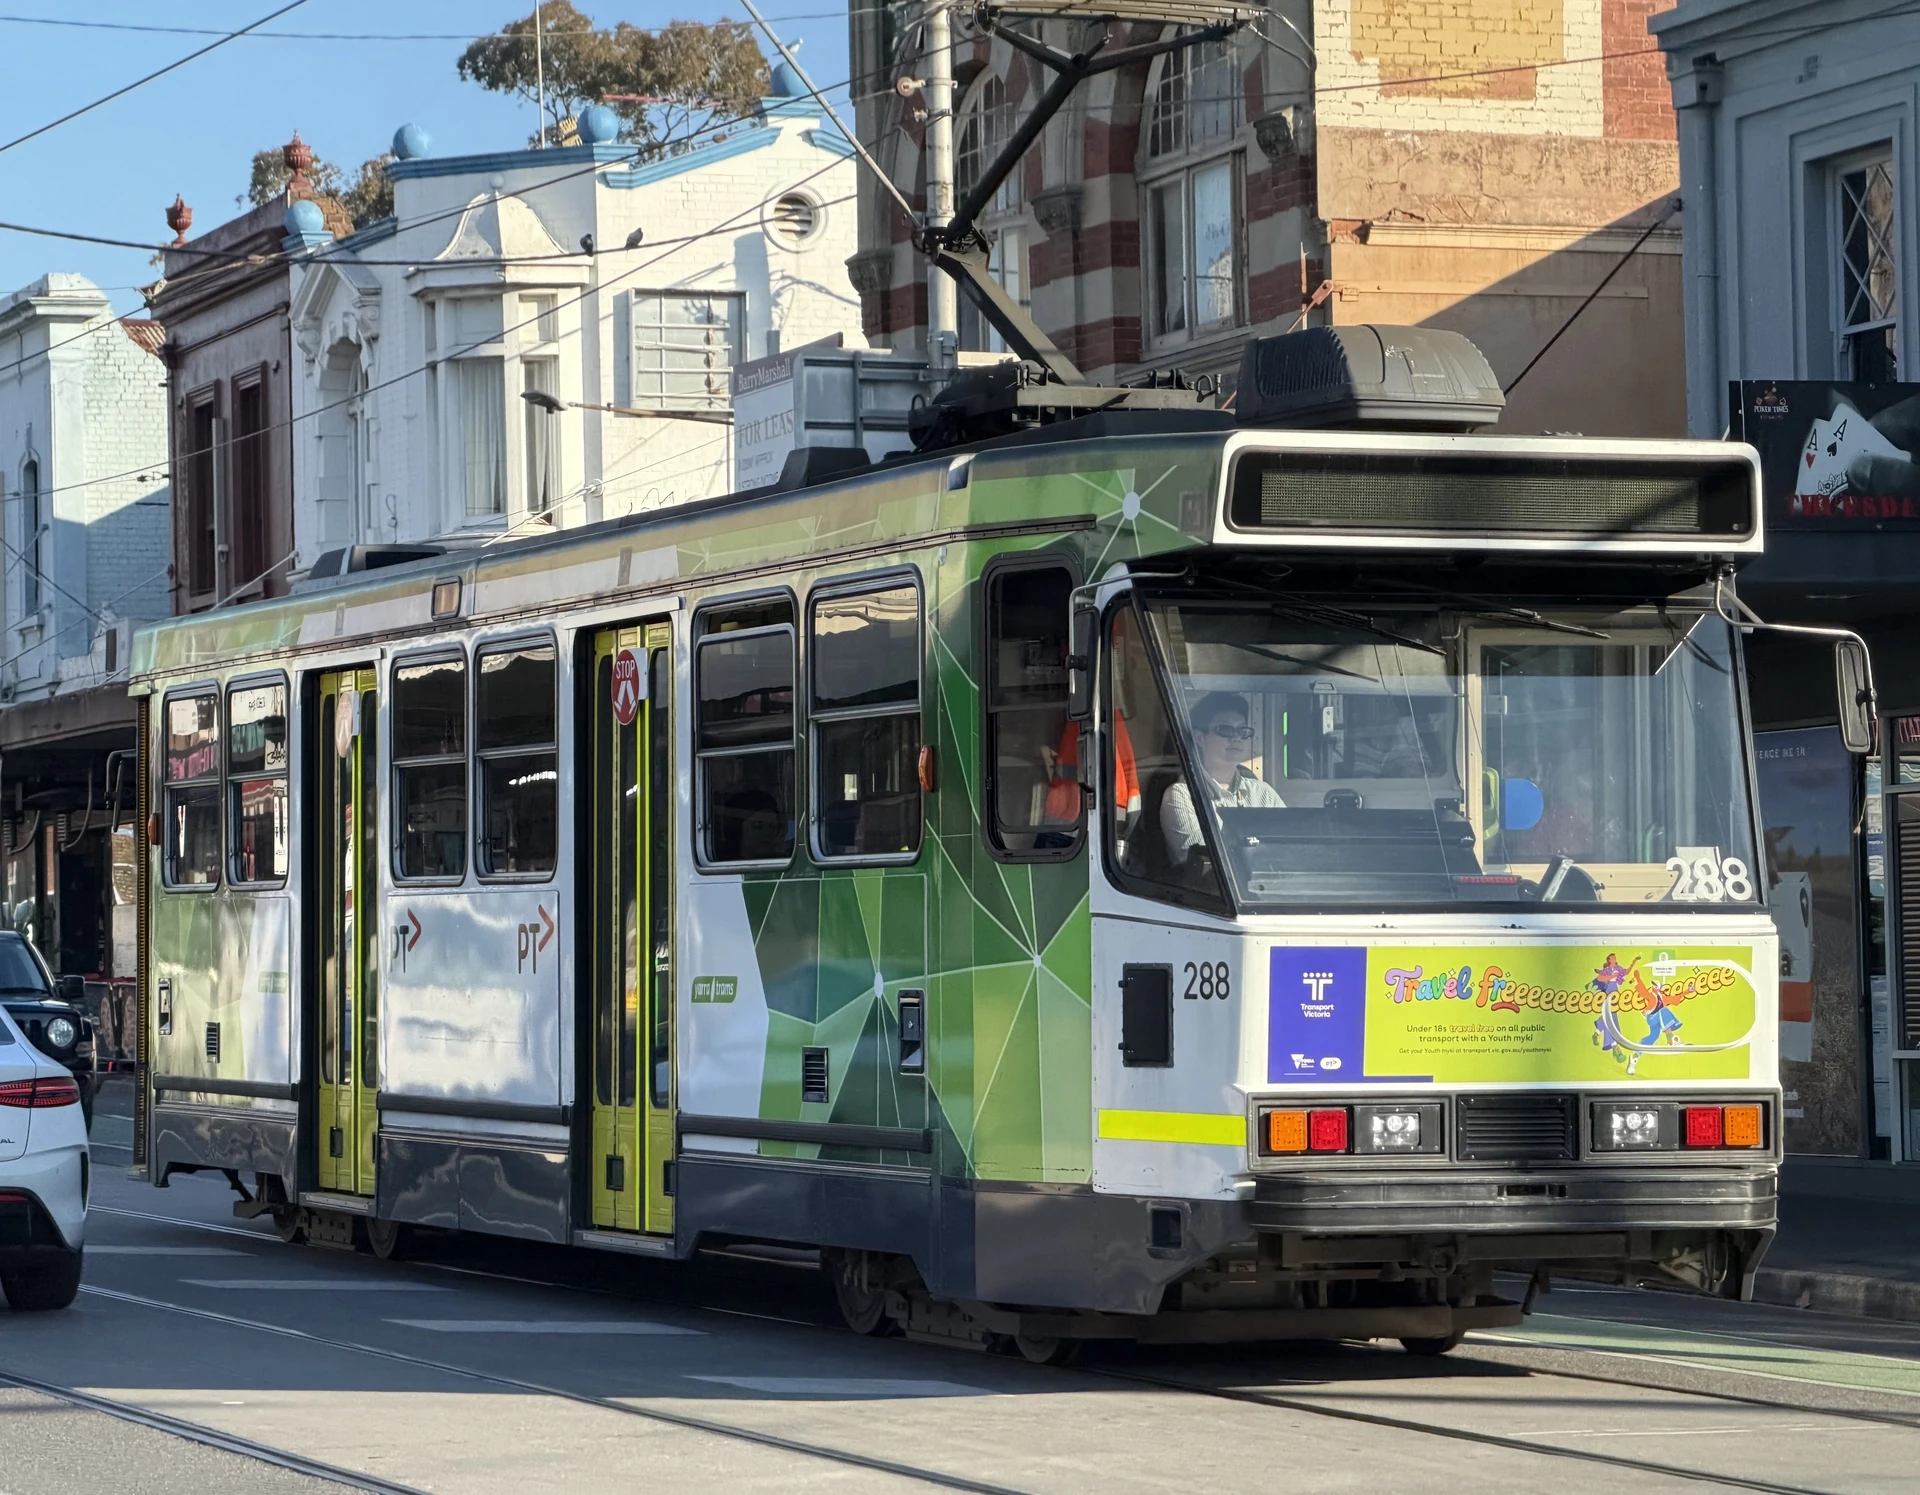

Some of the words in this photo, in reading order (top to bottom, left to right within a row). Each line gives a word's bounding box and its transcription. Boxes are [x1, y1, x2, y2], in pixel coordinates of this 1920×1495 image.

[738, 419, 762, 449] FOR
[1807, 428, 1819, 451] A
[1833, 419, 1848, 441] A
[615, 660, 636, 679] STOP
[1666, 857, 1752, 900] 288
[694, 983, 710, 1000] yarra
[715, 980, 734, 995] trams
[1183, 961, 1230, 1000] 288
[1384, 965, 1472, 1003] Travel
[1300, 1003, 1334, 1012] Transport
[1406, 1025, 1432, 1033] Under
[1434, 1025, 1447, 1033] 18s
[1449, 1024, 1475, 1033] travel
[1476, 1023, 1494, 1033] free
[1520, 1024, 1546, 1033] public
[1419, 1035, 1459, 1044] transport
[1461, 1034, 1479, 1042] with
[1488, 1034, 1512, 1042] Youth
[1513, 1033, 1533, 1043] myki
